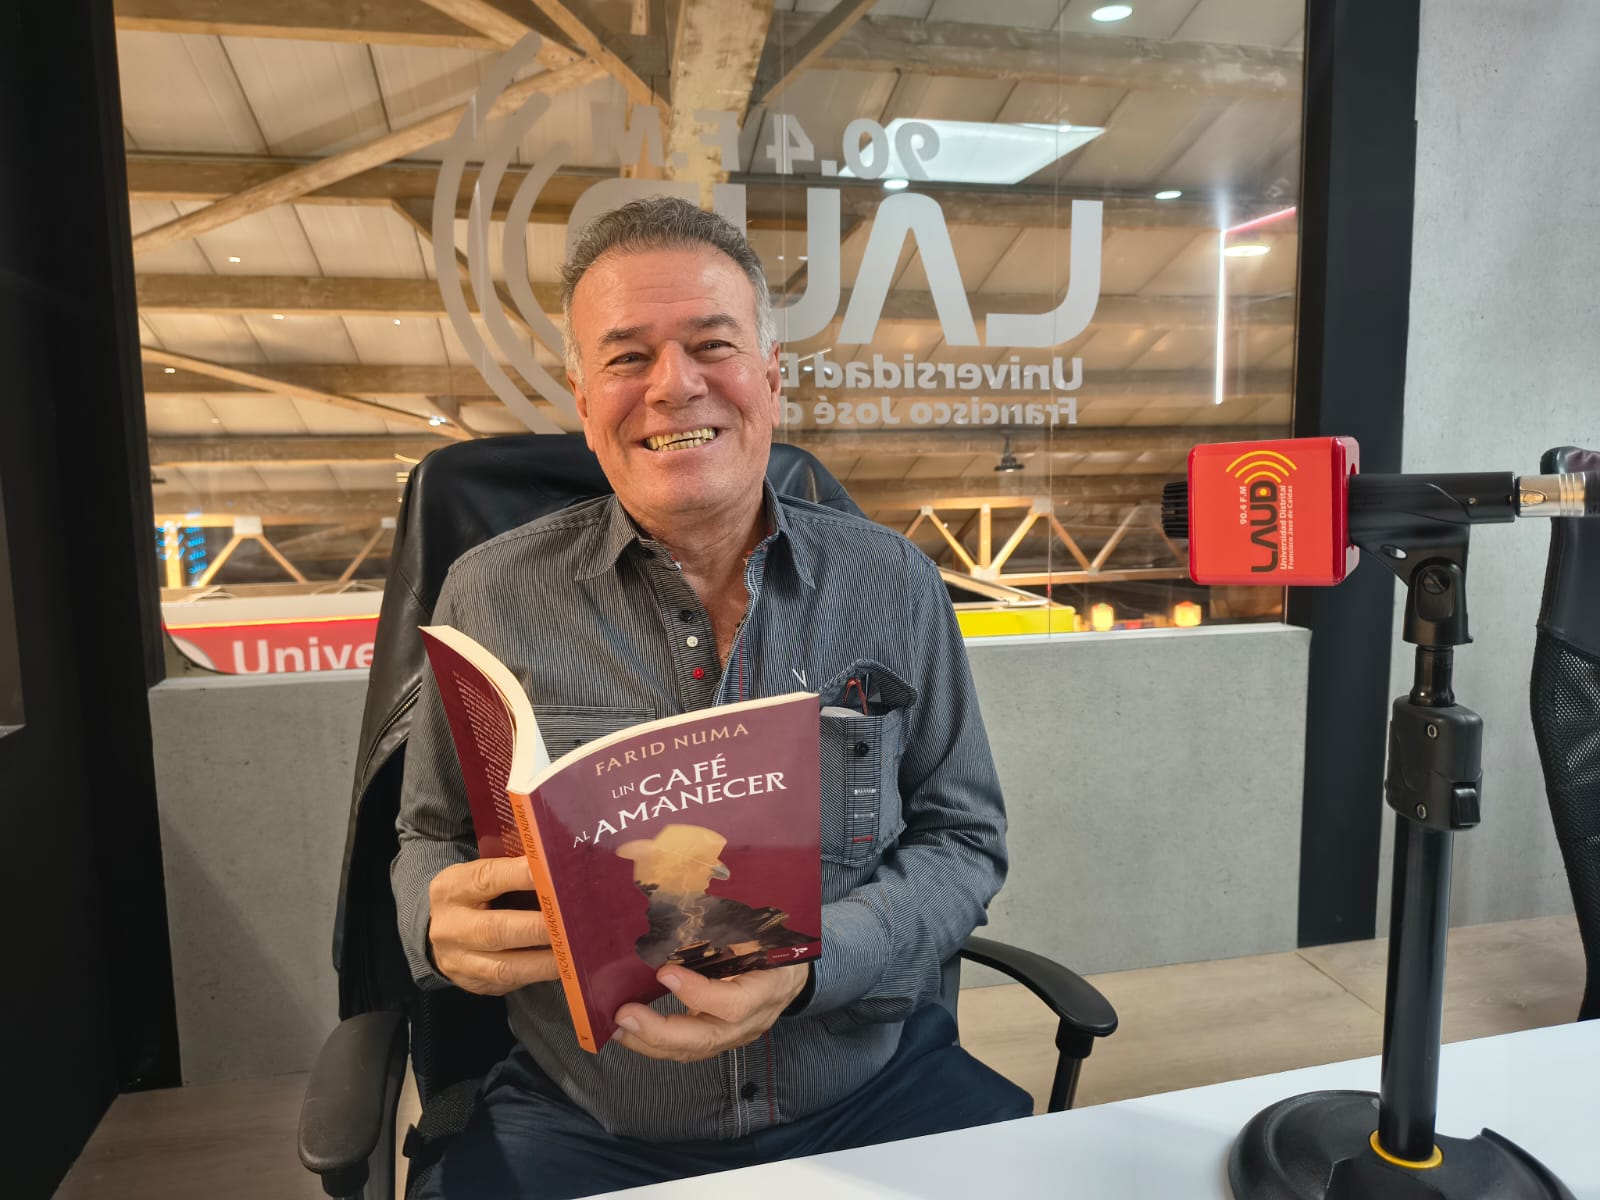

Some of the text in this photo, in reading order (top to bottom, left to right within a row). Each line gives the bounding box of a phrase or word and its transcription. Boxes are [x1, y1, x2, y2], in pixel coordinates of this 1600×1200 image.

[1249, 480, 1278, 573] LAUD
[1279, 485, 1288, 570] Universidad Distrital
[1287, 537, 1295, 570] Francisco
[595, 723, 749, 776] FARID NUMA
[611, 753, 728, 799] UN CAFÉ
[516, 803, 539, 860] FARID NUMA
[573, 831, 591, 848] AL
[593, 771, 788, 844] AMANECER
